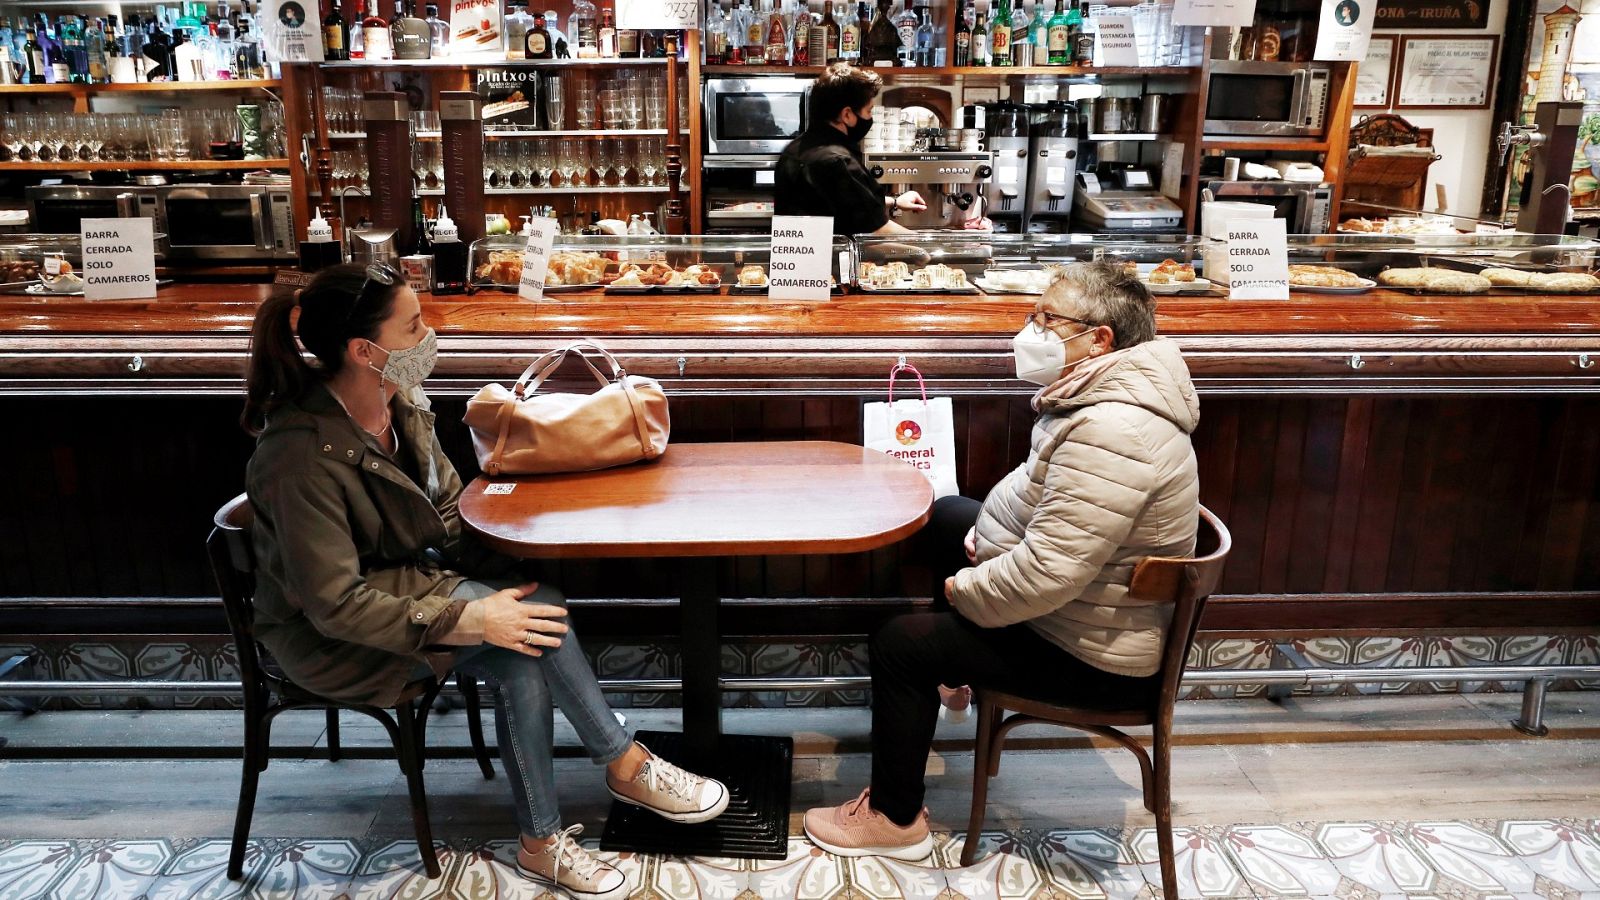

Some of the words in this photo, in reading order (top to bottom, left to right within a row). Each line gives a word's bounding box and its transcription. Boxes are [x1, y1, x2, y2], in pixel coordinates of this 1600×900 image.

[1376, 8, 1405, 18] ONA
[1420, 6, 1461, 18] IRUÑA
[477, 70, 537, 86] pintxos
[85, 231, 119, 239] BARRA
[530, 229, 543, 238] BARRA
[773, 230, 804, 238] BARRA
[1229, 232, 1259, 240] BARRA
[86, 245, 133, 254] CERRADA
[527, 245, 543, 255] CERRADA
[772, 246, 815, 255] CERRADA
[1229, 248, 1271, 256] CERRADA
[86, 261, 113, 269] SOLO
[523, 261, 534, 270] SOLO
[771, 262, 796, 270] SOLO
[1230, 264, 1254, 272] SOLO
[87, 274, 151, 285] CAMAREROS
[520, 277, 543, 290] CAMAREROS
[770, 278, 828, 288] CAMAREROS
